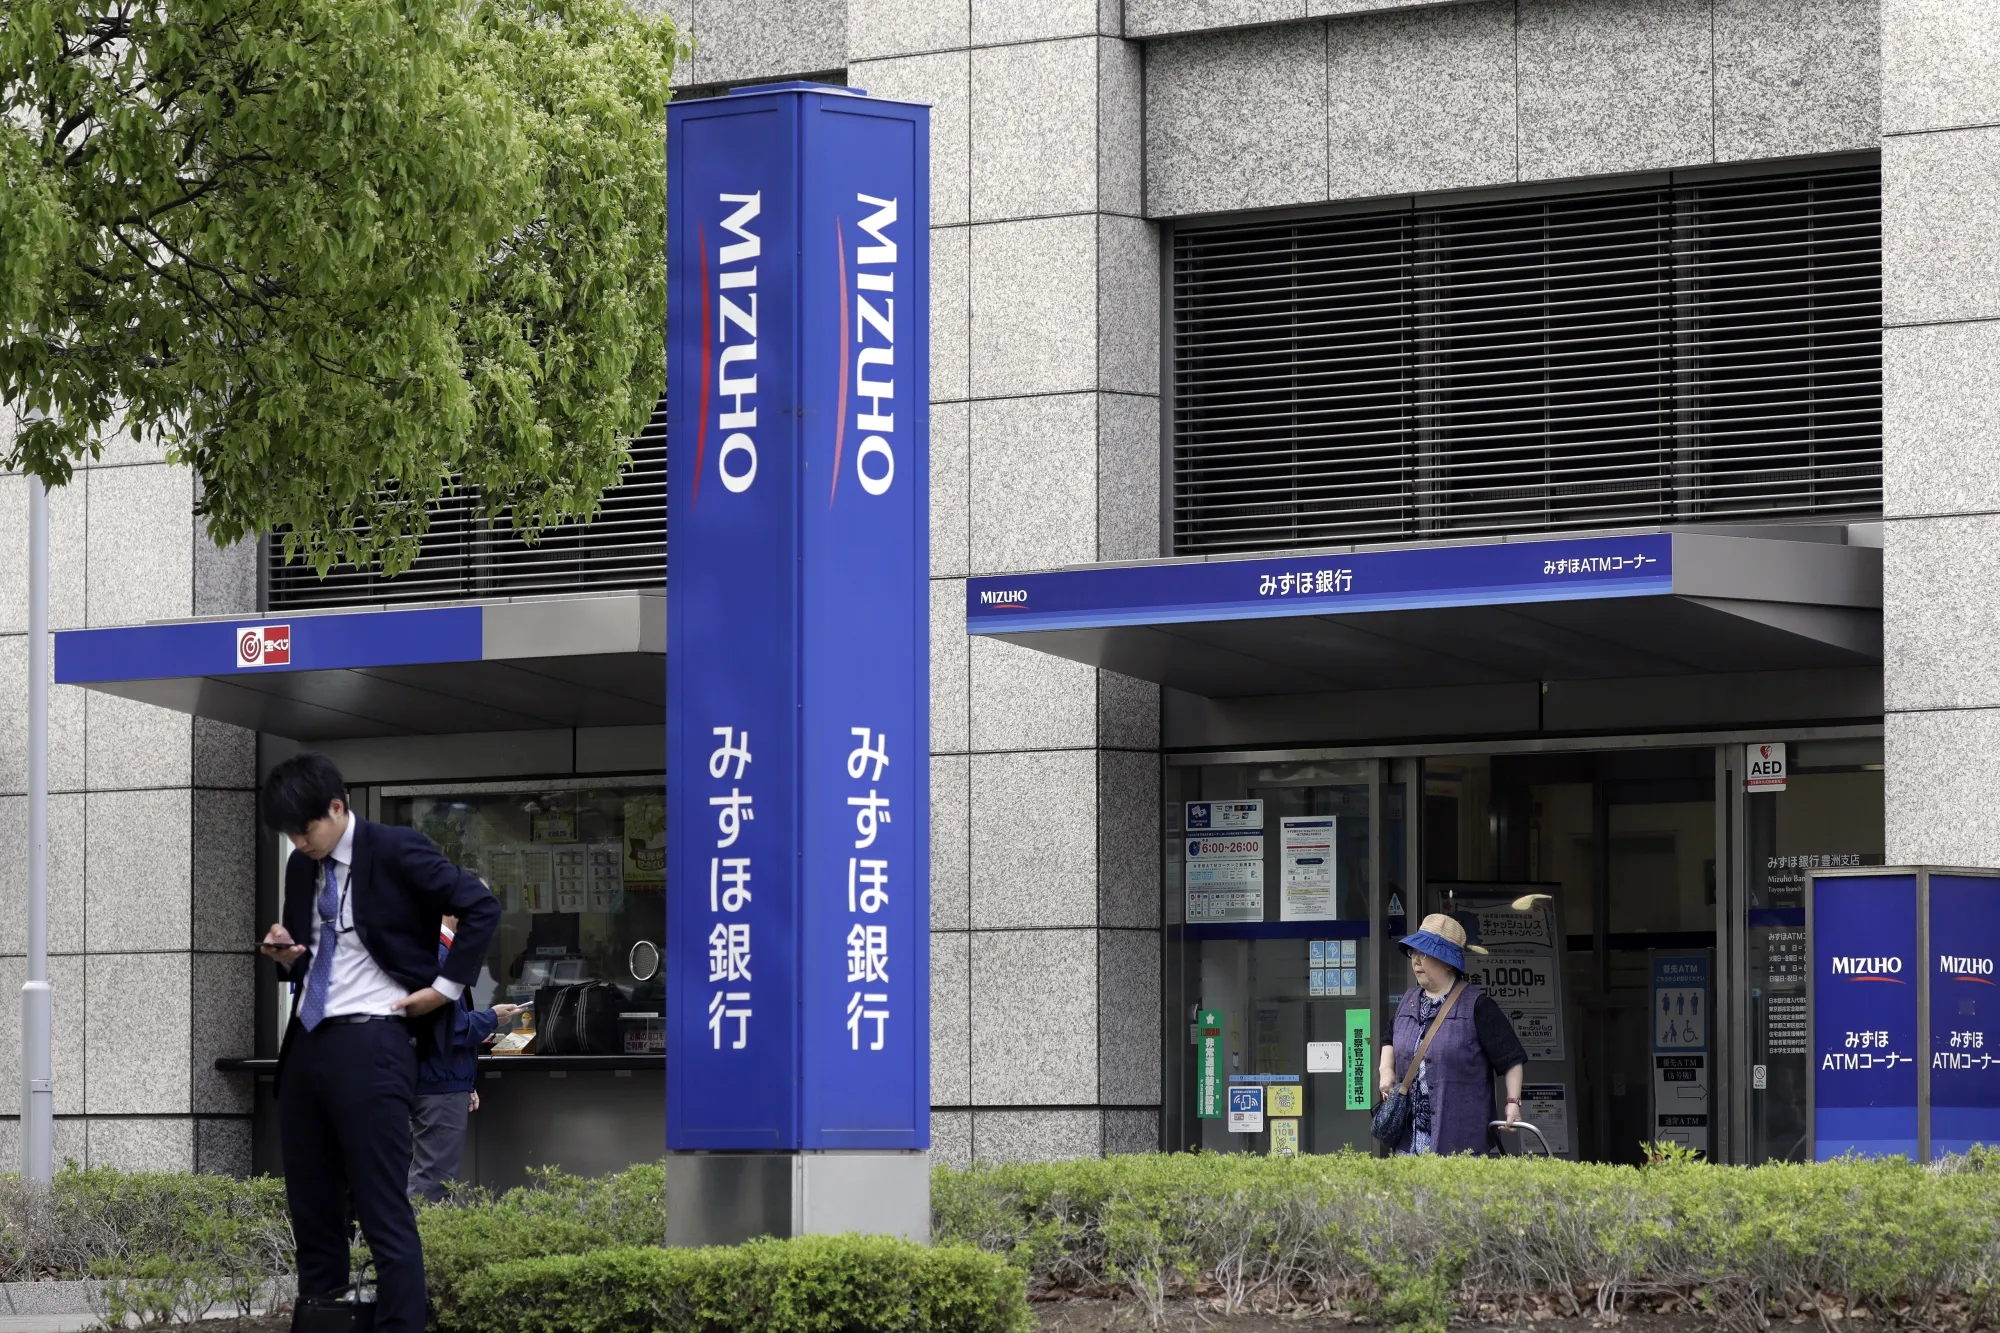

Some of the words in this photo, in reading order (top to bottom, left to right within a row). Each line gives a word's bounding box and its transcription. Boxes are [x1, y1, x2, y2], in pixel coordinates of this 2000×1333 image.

[719, 190, 761, 493] MIZUHO
[857, 192, 898, 496] MIZUHO
[1543, 553, 1657, 575] みずほATMコーナー
[1260, 569, 1353, 596] みずほ銀行
[981, 590, 1028, 604] MIZUHO
[264, 639, 289, 652] 宝くじ
[1751, 760, 1782, 776] AED
[1767, 855, 1820, 869] みずほ銀行
[1821, 854, 1860, 867] 豊洲支店
[709, 726, 754, 1050] みずほ銀行
[1767, 875, 1792, 883] Mizuho
[847, 726, 892, 1051] みずほ銀行
[1482, 920, 1542, 930] キャッシュレス
[1483, 929, 1543, 937] スタートキャンペーン
[1832, 956, 1902, 975] MIZUHO
[1940, 955, 1994, 975] MIZUHO
[1844, 1030, 1889, 1048] みずほ
[1950, 1030, 1984, 1049] みずほ
[1822, 1053, 1913, 1070] ATMコーナー
[1932, 1053, 2000, 1070] ATMコーナー
